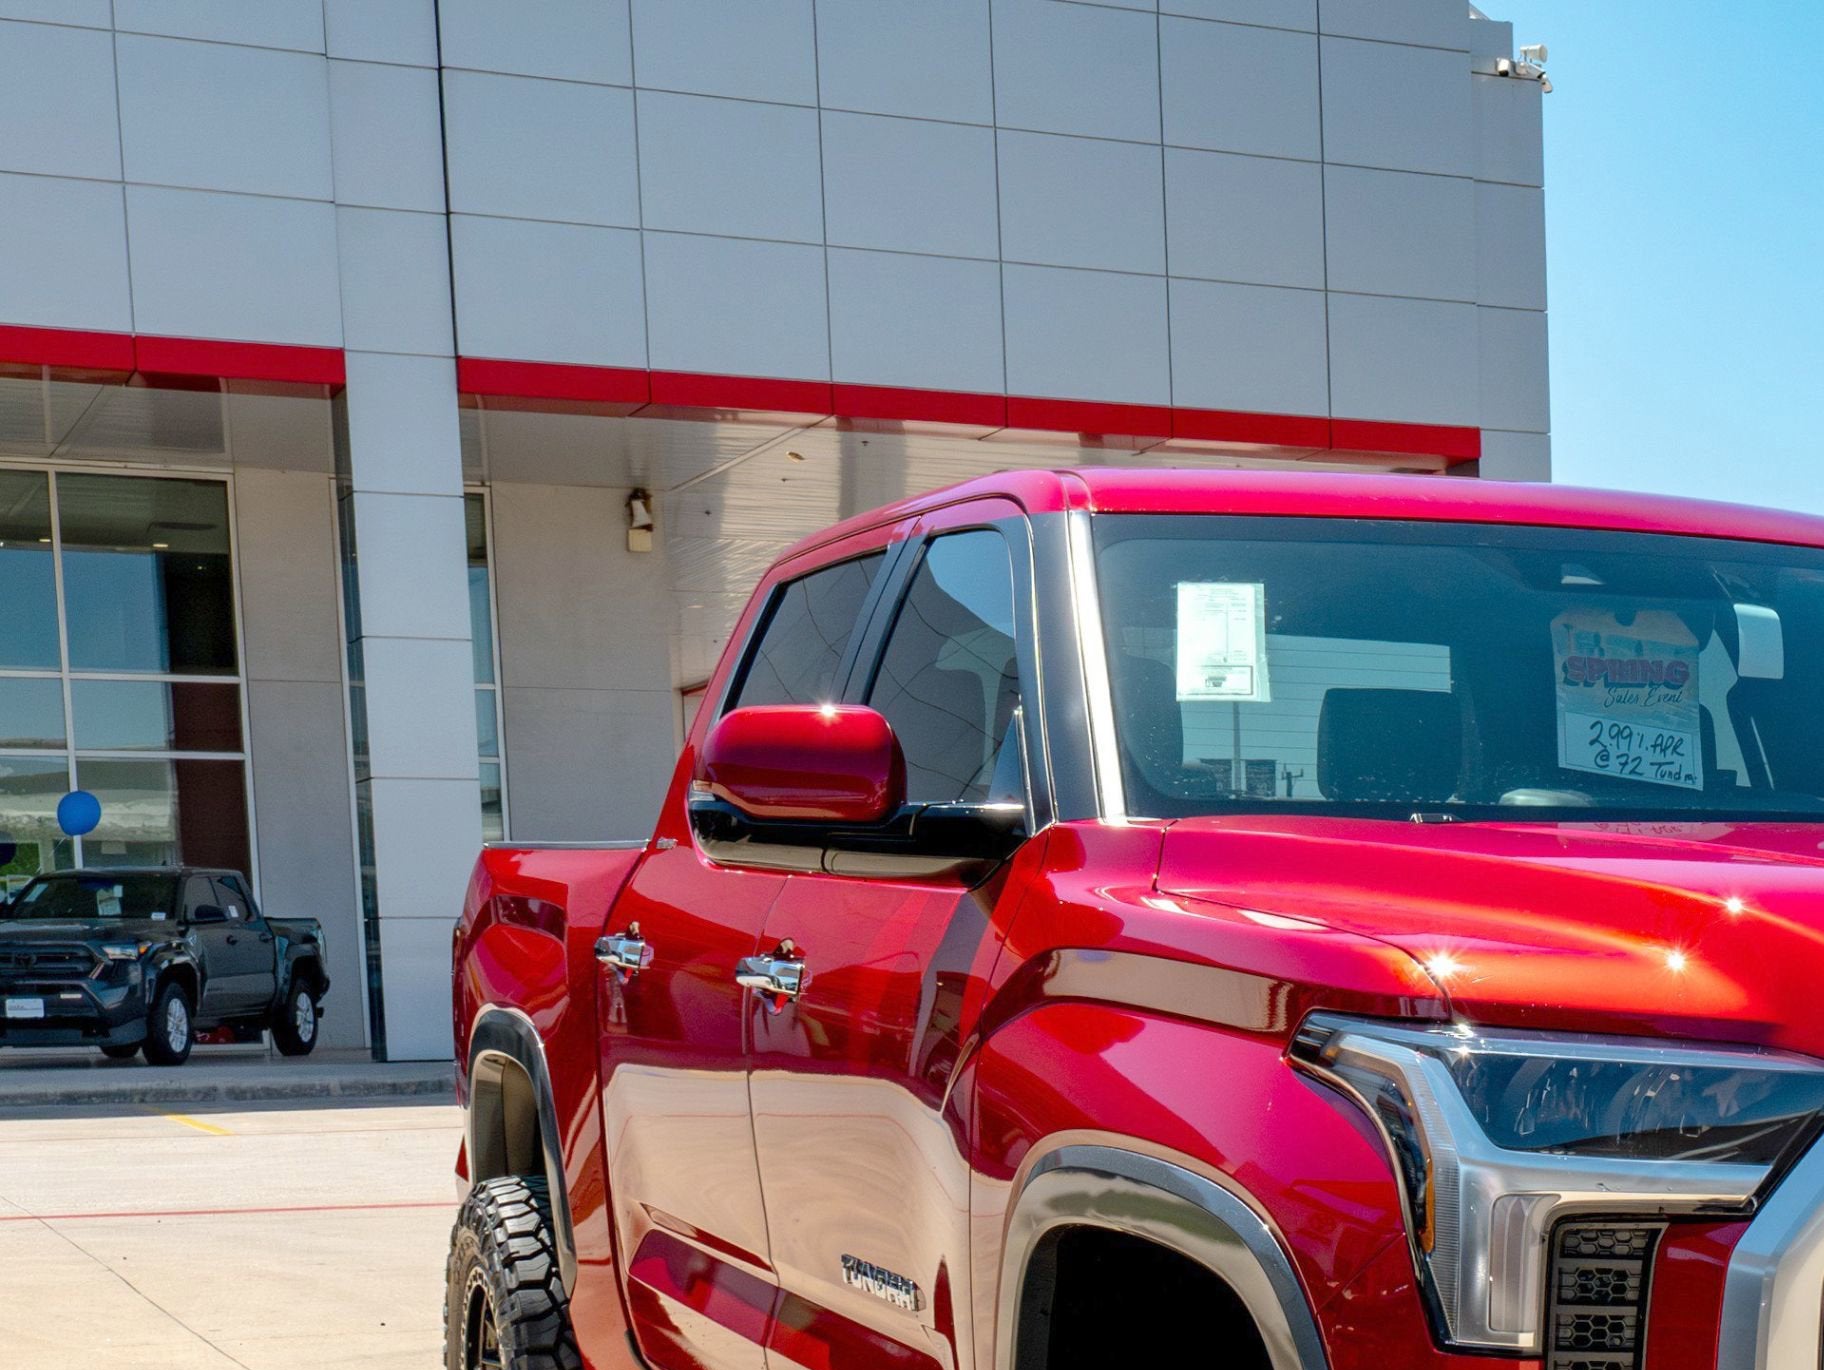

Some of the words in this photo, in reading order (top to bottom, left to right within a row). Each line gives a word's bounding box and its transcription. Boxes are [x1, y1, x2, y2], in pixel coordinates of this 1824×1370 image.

[1563, 655, 1690, 689] SPRING
[1604, 687, 1640, 708] Sales
[1640, 687, 1683, 708] Event
[1650, 733, 1685, 758] APR
[1594, 748, 1610, 768] @
[1616, 753, 1645, 775] 72
